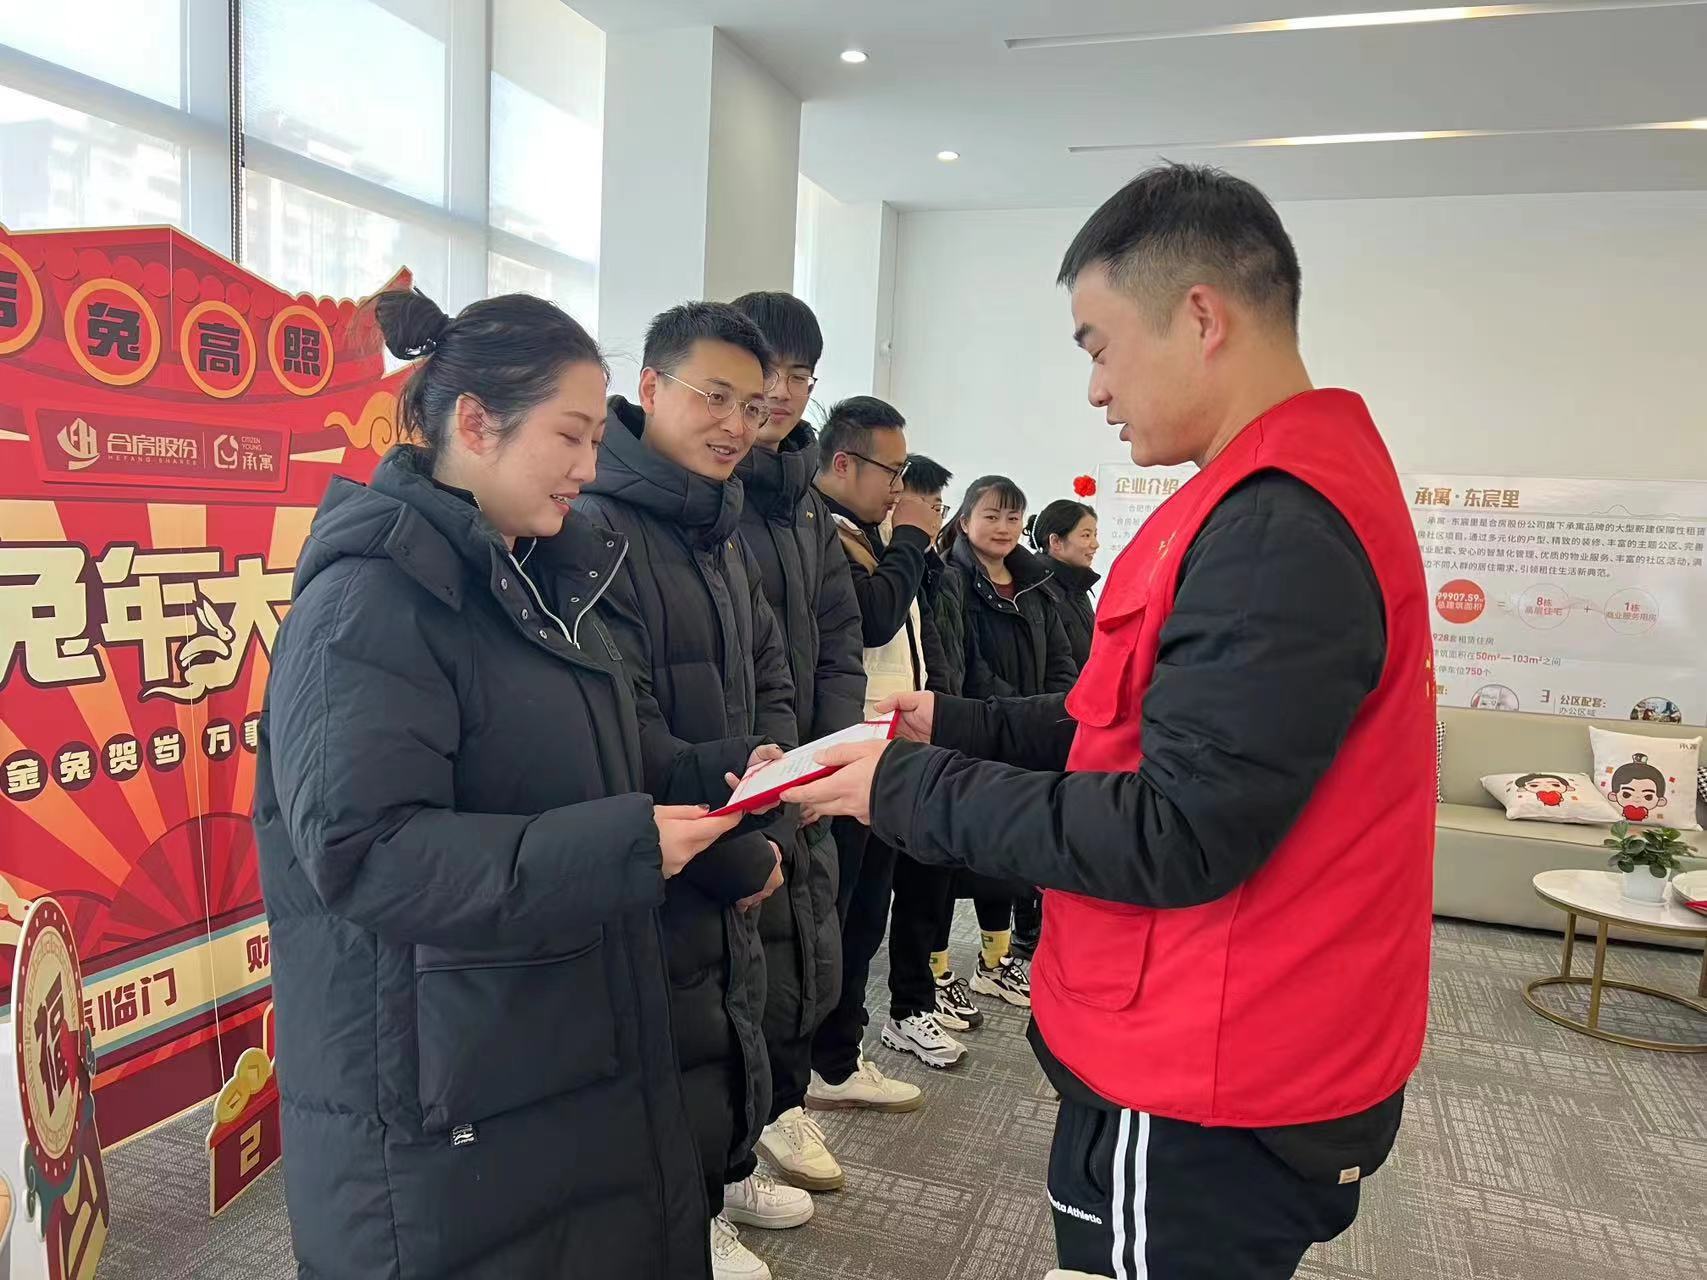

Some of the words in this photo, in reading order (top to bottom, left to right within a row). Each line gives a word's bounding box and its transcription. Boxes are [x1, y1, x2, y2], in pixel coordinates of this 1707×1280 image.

[107, 432, 198, 460] 合房股份
[242, 451, 273, 471] 承寓
[239, 1120, 261, 1178] 2
